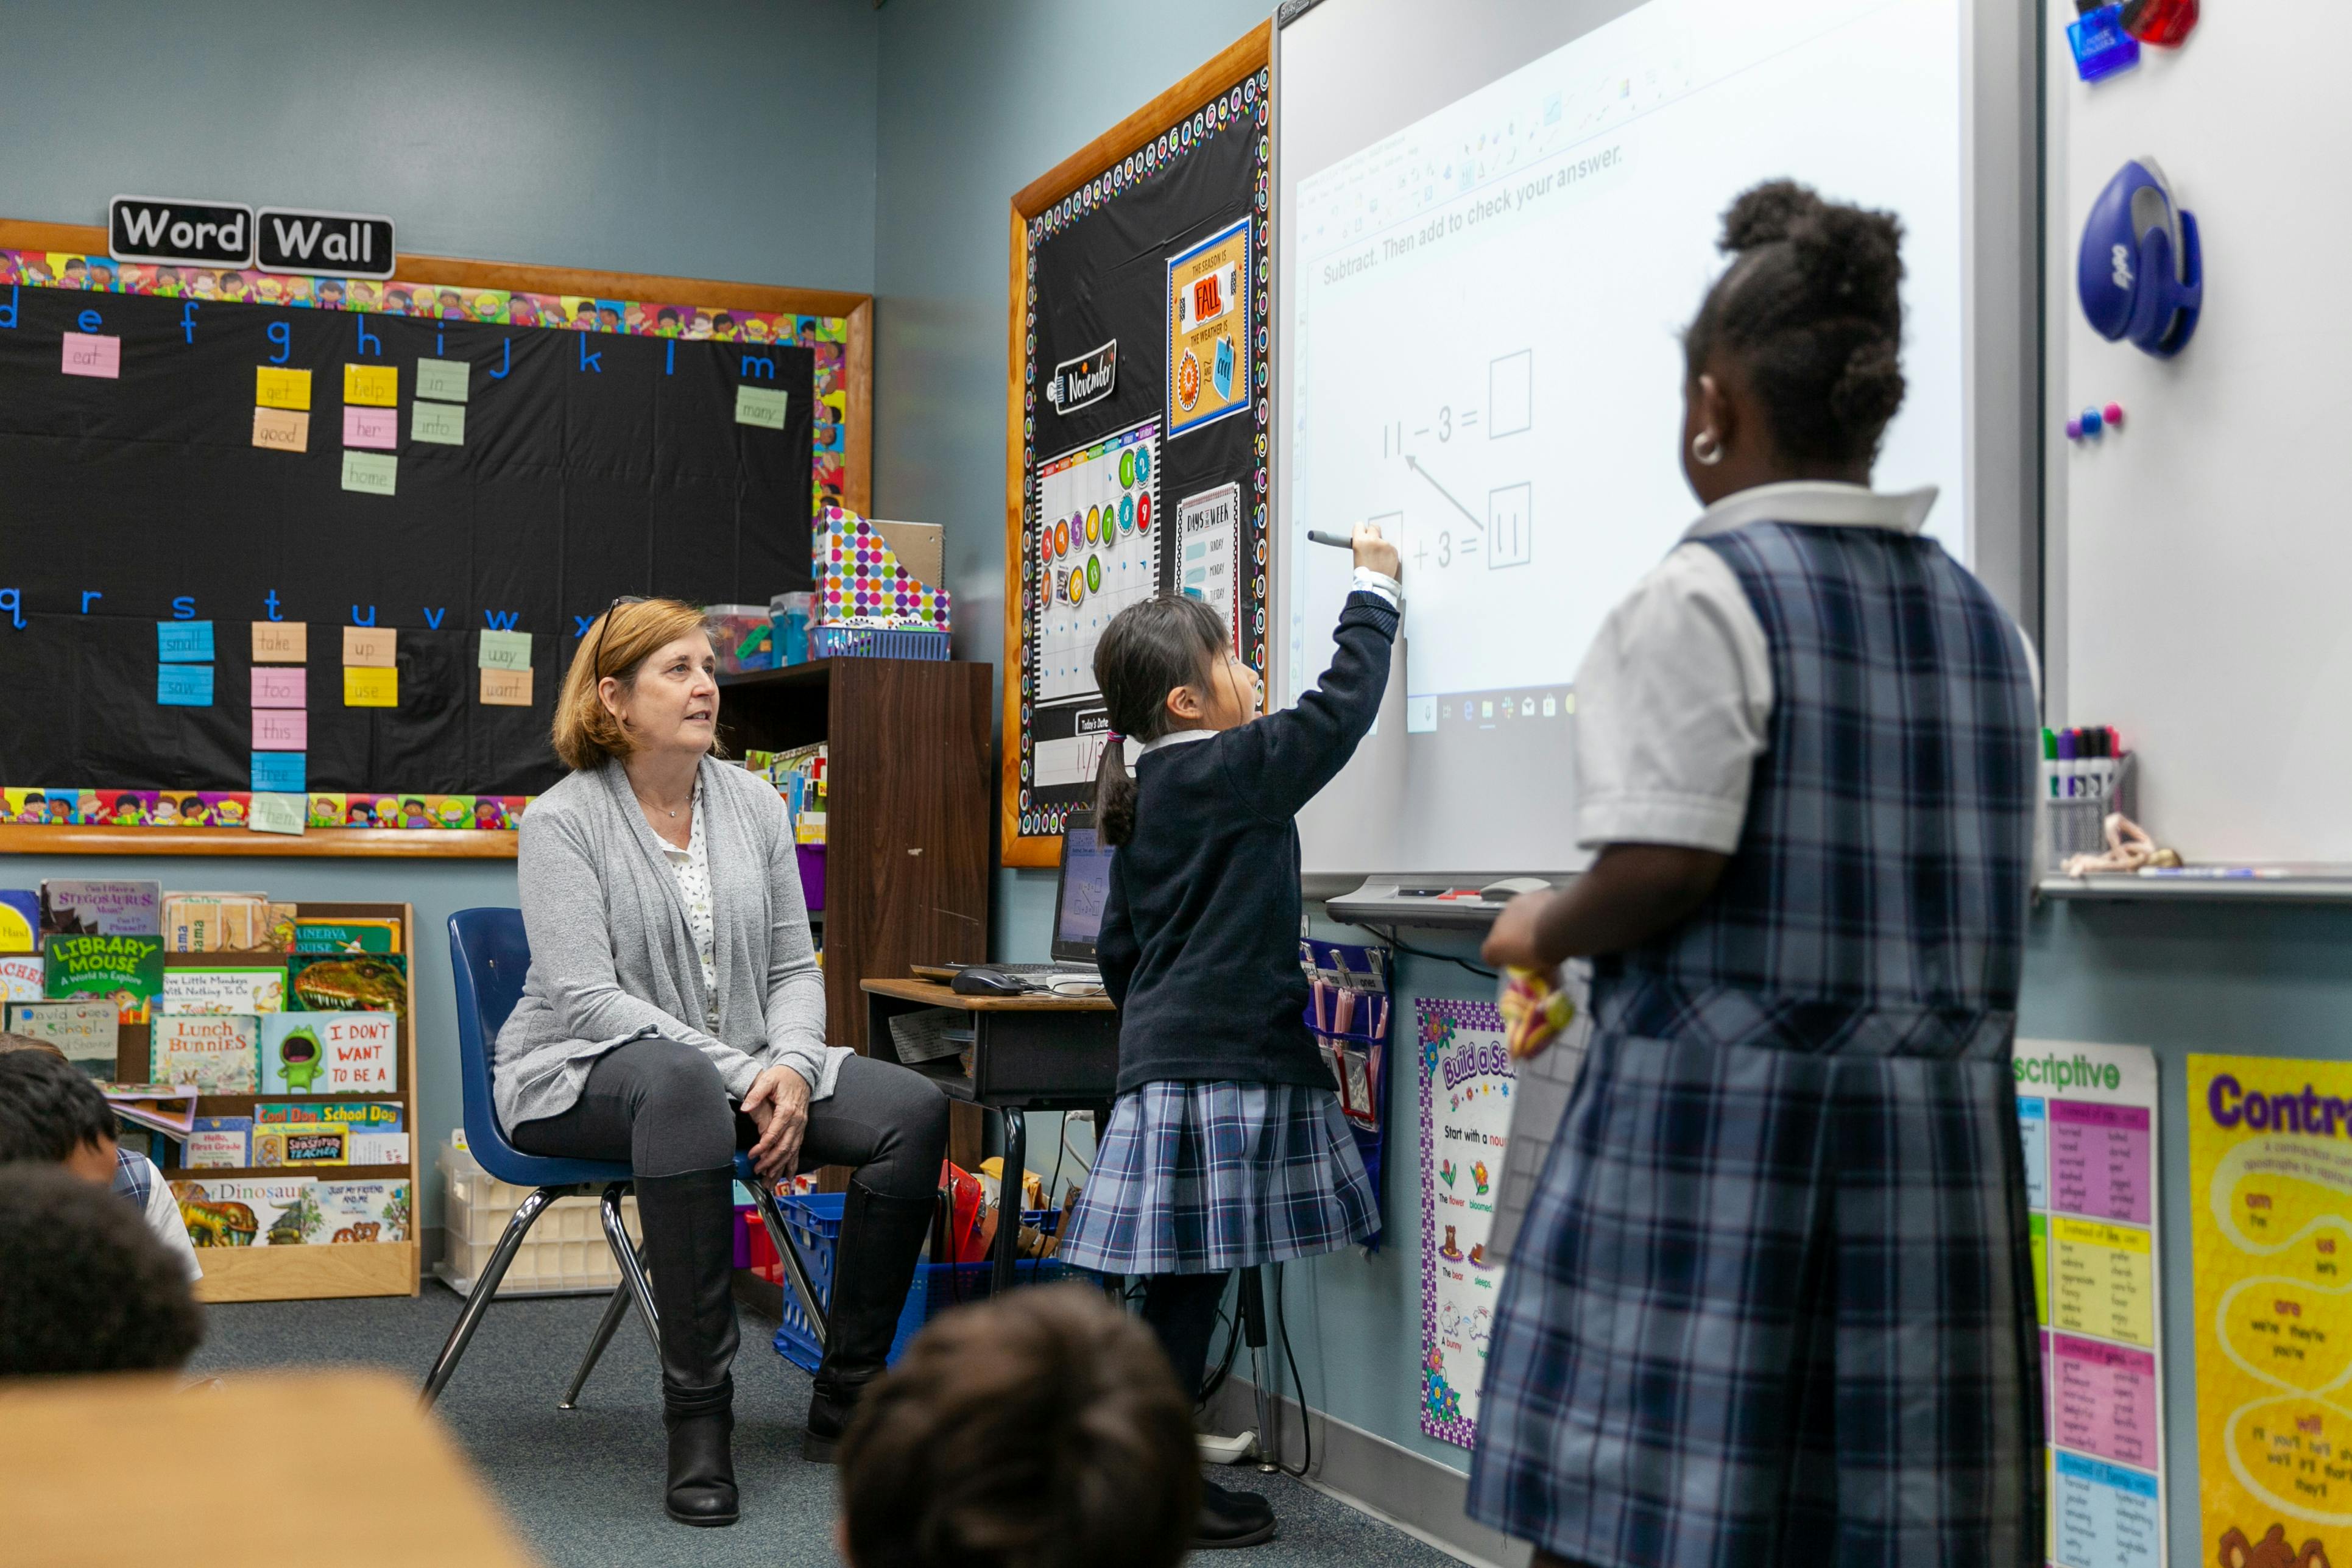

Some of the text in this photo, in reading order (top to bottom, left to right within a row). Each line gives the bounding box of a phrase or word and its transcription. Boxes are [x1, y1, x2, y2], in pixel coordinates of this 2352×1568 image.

[1323, 142, 1623, 286] Subtract. Then add to check your answer.
[121, 206, 243, 252] Word
[273, 218, 371, 261] Wall
[1192, 250, 1226, 274] THE SEASON IS
[1196, 280, 1219, 316] FALL
[77, 309, 102, 331] e
[180, 302, 199, 344] f
[267, 321, 290, 363] g
[358, 314, 381, 355] h
[437, 322, 445, 356] i
[1200, 325, 1223, 345] WEATHER
[1223, 320, 1228, 331] IS
[72, 344, 100, 366] eat
[580, 331, 601, 373] k
[741, 353, 775, 380] m
[1217, 358, 1230, 381] COOL
[355, 376, 384, 401] help
[430, 377, 443, 391] in
[1069, 355, 1111, 403] November
[267, 380, 291, 403] get
[743, 400, 777, 422] many
[357, 415, 381, 437] her
[423, 415, 450, 435] into
[1438, 405, 1452, 443] 3
[260, 423, 297, 446] good
[350, 464, 387, 486] home
[1127, 461, 1131, 478] 1
[1139, 457, 1146, 474] 2
[1124, 506, 1130, 521] 8
[1142, 504, 1148, 521] 9
[1187, 503, 1229, 532] DAYS WEEK
[1075, 523, 1080, 539] 5
[1091, 518, 1095, 533] 6
[1106, 517, 1111, 533] 7
[1045, 538, 1051, 553] 3
[1059, 531, 1065, 545] 4
[1210, 538, 1224, 553] SUNDAY
[1438, 531, 1452, 568] 3
[1090, 565, 1098, 584] 13
[1210, 562, 1224, 577] MONDAY
[82, 590, 102, 614] r
[1210, 587, 1224, 603] TUESDAY
[0, 588, 27, 630] q
[172, 596, 196, 620] s
[264, 589, 283, 623] t
[351, 604, 376, 627] u
[423, 607, 445, 630] v
[484, 609, 519, 630] w
[573, 615, 595, 638] x
[166, 631, 200, 651] small
[259, 630, 290, 651] take
[355, 641, 375, 660] up
[487, 646, 518, 668] way
[168, 679, 195, 694] saw
[261, 676, 291, 699] too
[355, 686, 379, 699] use
[486, 677, 521, 697] want
[261, 718, 291, 740] this
[1082, 718, 1109, 730] Today's Date
[58, 892, 153, 906] STEGOSAURUS
[52, 936, 157, 962] LIBRARY
[296, 943, 333, 953] OUISE
[68, 955, 139, 974] MOUSE
[61, 970, 142, 986] A World to Explore
[182, 976, 247, 985] Little Monkeys
[1360, 979, 1376, 987] ones
[186, 987, 220, 998] Nothing
[21, 1006, 110, 1020] David Goes
[177, 1021, 233, 1037] Lunch
[330, 1023, 390, 1040] I DON'T
[337, 1045, 383, 1061] WANT
[333, 1067, 386, 1082] TO BE A
[1443, 1043, 1476, 1087] Build
[1478, 1048, 1488, 1073] a
[259, 1108, 286, 1123] Cool
[324, 1106, 366, 1121] School
[370, 1106, 397, 1123] Dog
[289, 1137, 341, 1150] SUBSTITUTE
[1445, 1125, 1462, 1140] Start
[1464, 1129, 1480, 1143] with
[1482, 1134, 1488, 1144] a
[191, 1143, 213, 1151] First
[289, 1146, 339, 1158] TEACHER
[328, 1186, 343, 1195] JUST
[1439, 1193, 1465, 1207] The flower
[1443, 1267, 1492, 1290] The bear sleeps.
[2251, 1320, 2326, 1343] we're they're
[1441, 1336, 1462, 1354] A bunny
[2273, 1344, 2304, 1360] you're
[2295, 1477, 2328, 1497] they'll
